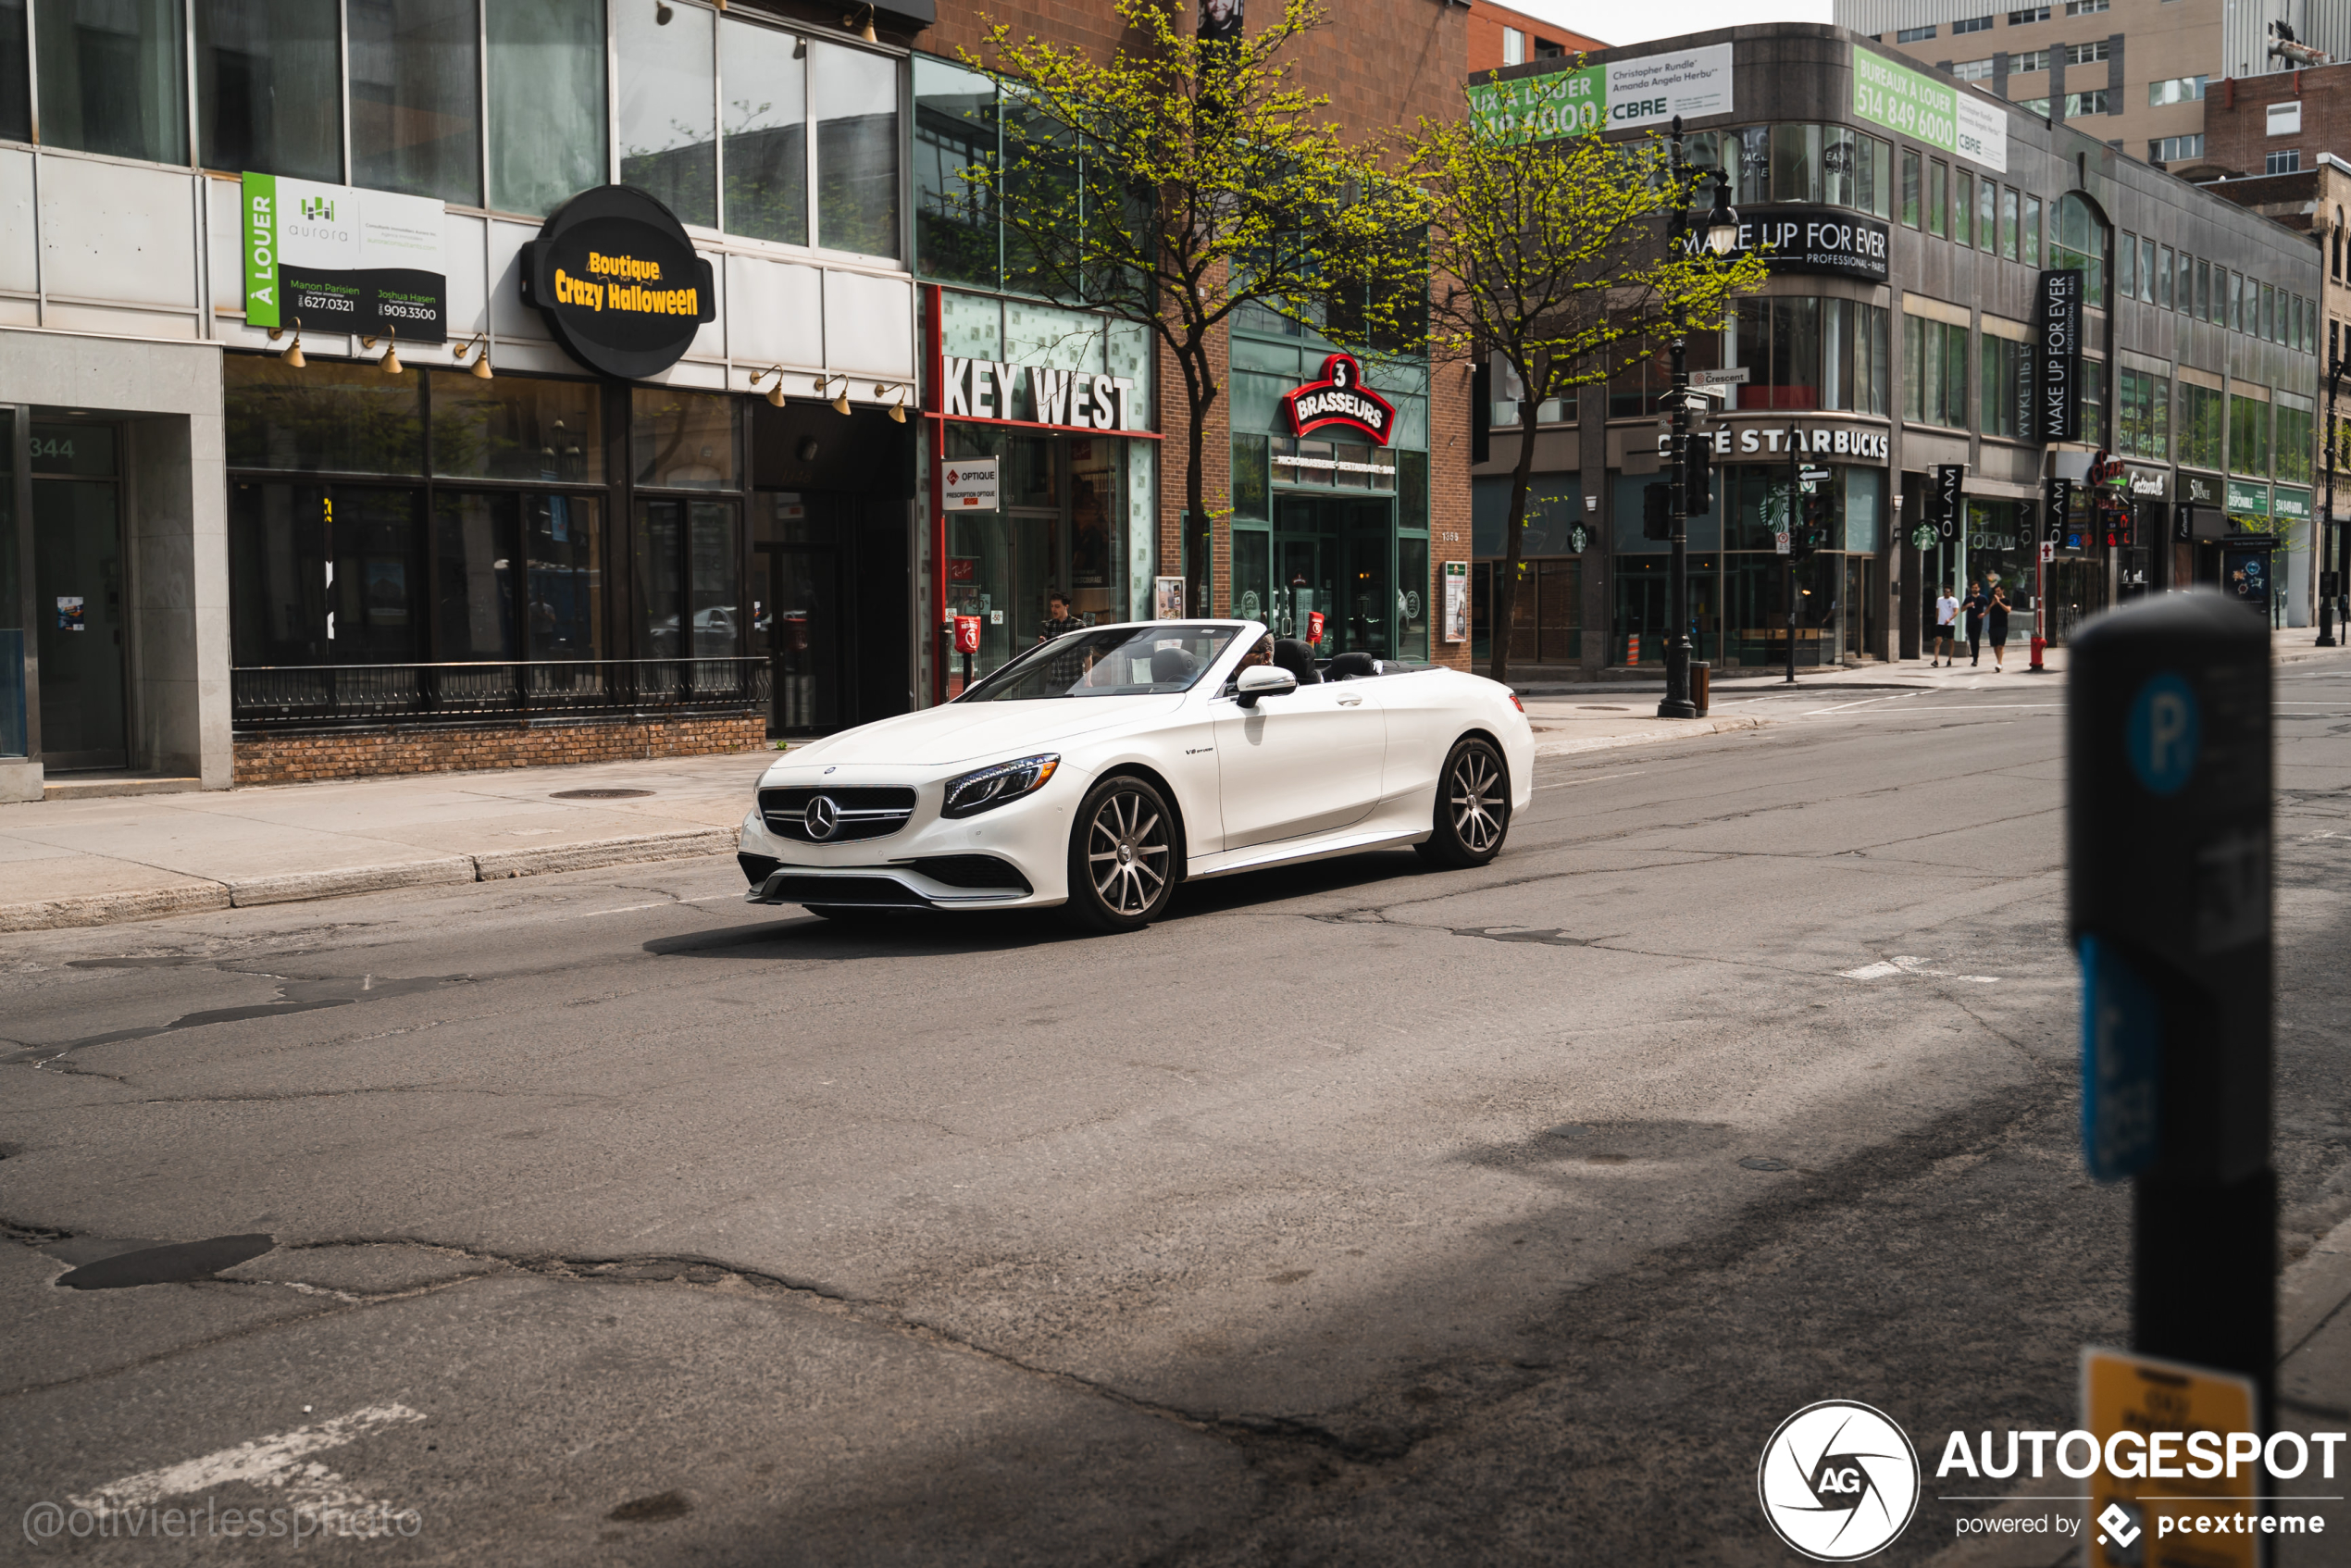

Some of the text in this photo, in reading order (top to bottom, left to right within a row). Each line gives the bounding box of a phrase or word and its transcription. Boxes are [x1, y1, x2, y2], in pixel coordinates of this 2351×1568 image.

[1612, 64, 1663, 81] Christopher
[1612, 80, 1649, 93] Amanda
[1651, 74, 1682, 87] Angela
[1525, 77, 1592, 106] LOUER
[1860, 58, 1952, 115] BUREAUX À LOUER
[1612, 97, 1667, 120] CBRE
[1858, 83, 1953, 147] 514 849 6000
[1959, 133, 1982, 156] CBRE
[289, 224, 349, 243] aurora
[1683, 222, 1885, 260] MAE UP FOR EVER
[251, 195, 274, 306] À LOUER
[589, 252, 660, 281] Boutique
[291, 280, 360, 295] Manon Parisien
[378, 289, 436, 304] Joshua Hasen
[555, 268, 698, 316] Crazy Halloween
[305, 296, 354, 312] 627.0321
[384, 305, 436, 321] 909.3300
[2067, 302, 2075, 355] PROFESSIONAL
[2047, 276, 2066, 436] MAKE UP FOR EVER
[1334, 362, 1346, 388] 3
[1706, 374, 1744, 384] Crescent
[942, 355, 1135, 431] KEY WEST
[1296, 392, 1383, 429] BRASSEURS
[1659, 424, 1888, 459] CÉ STARBUCKS
[962, 471, 995, 481] OPTIQUE
[1277, 455, 1396, 476] MICROBRASSERIE RESTAURANT BAR
[1942, 468, 1957, 538] OLAM
[2050, 482, 2065, 544] OLAM
[2229, 494, 2254, 509] DISPONIBLE
[1972, 534, 2016, 551] OLAM
